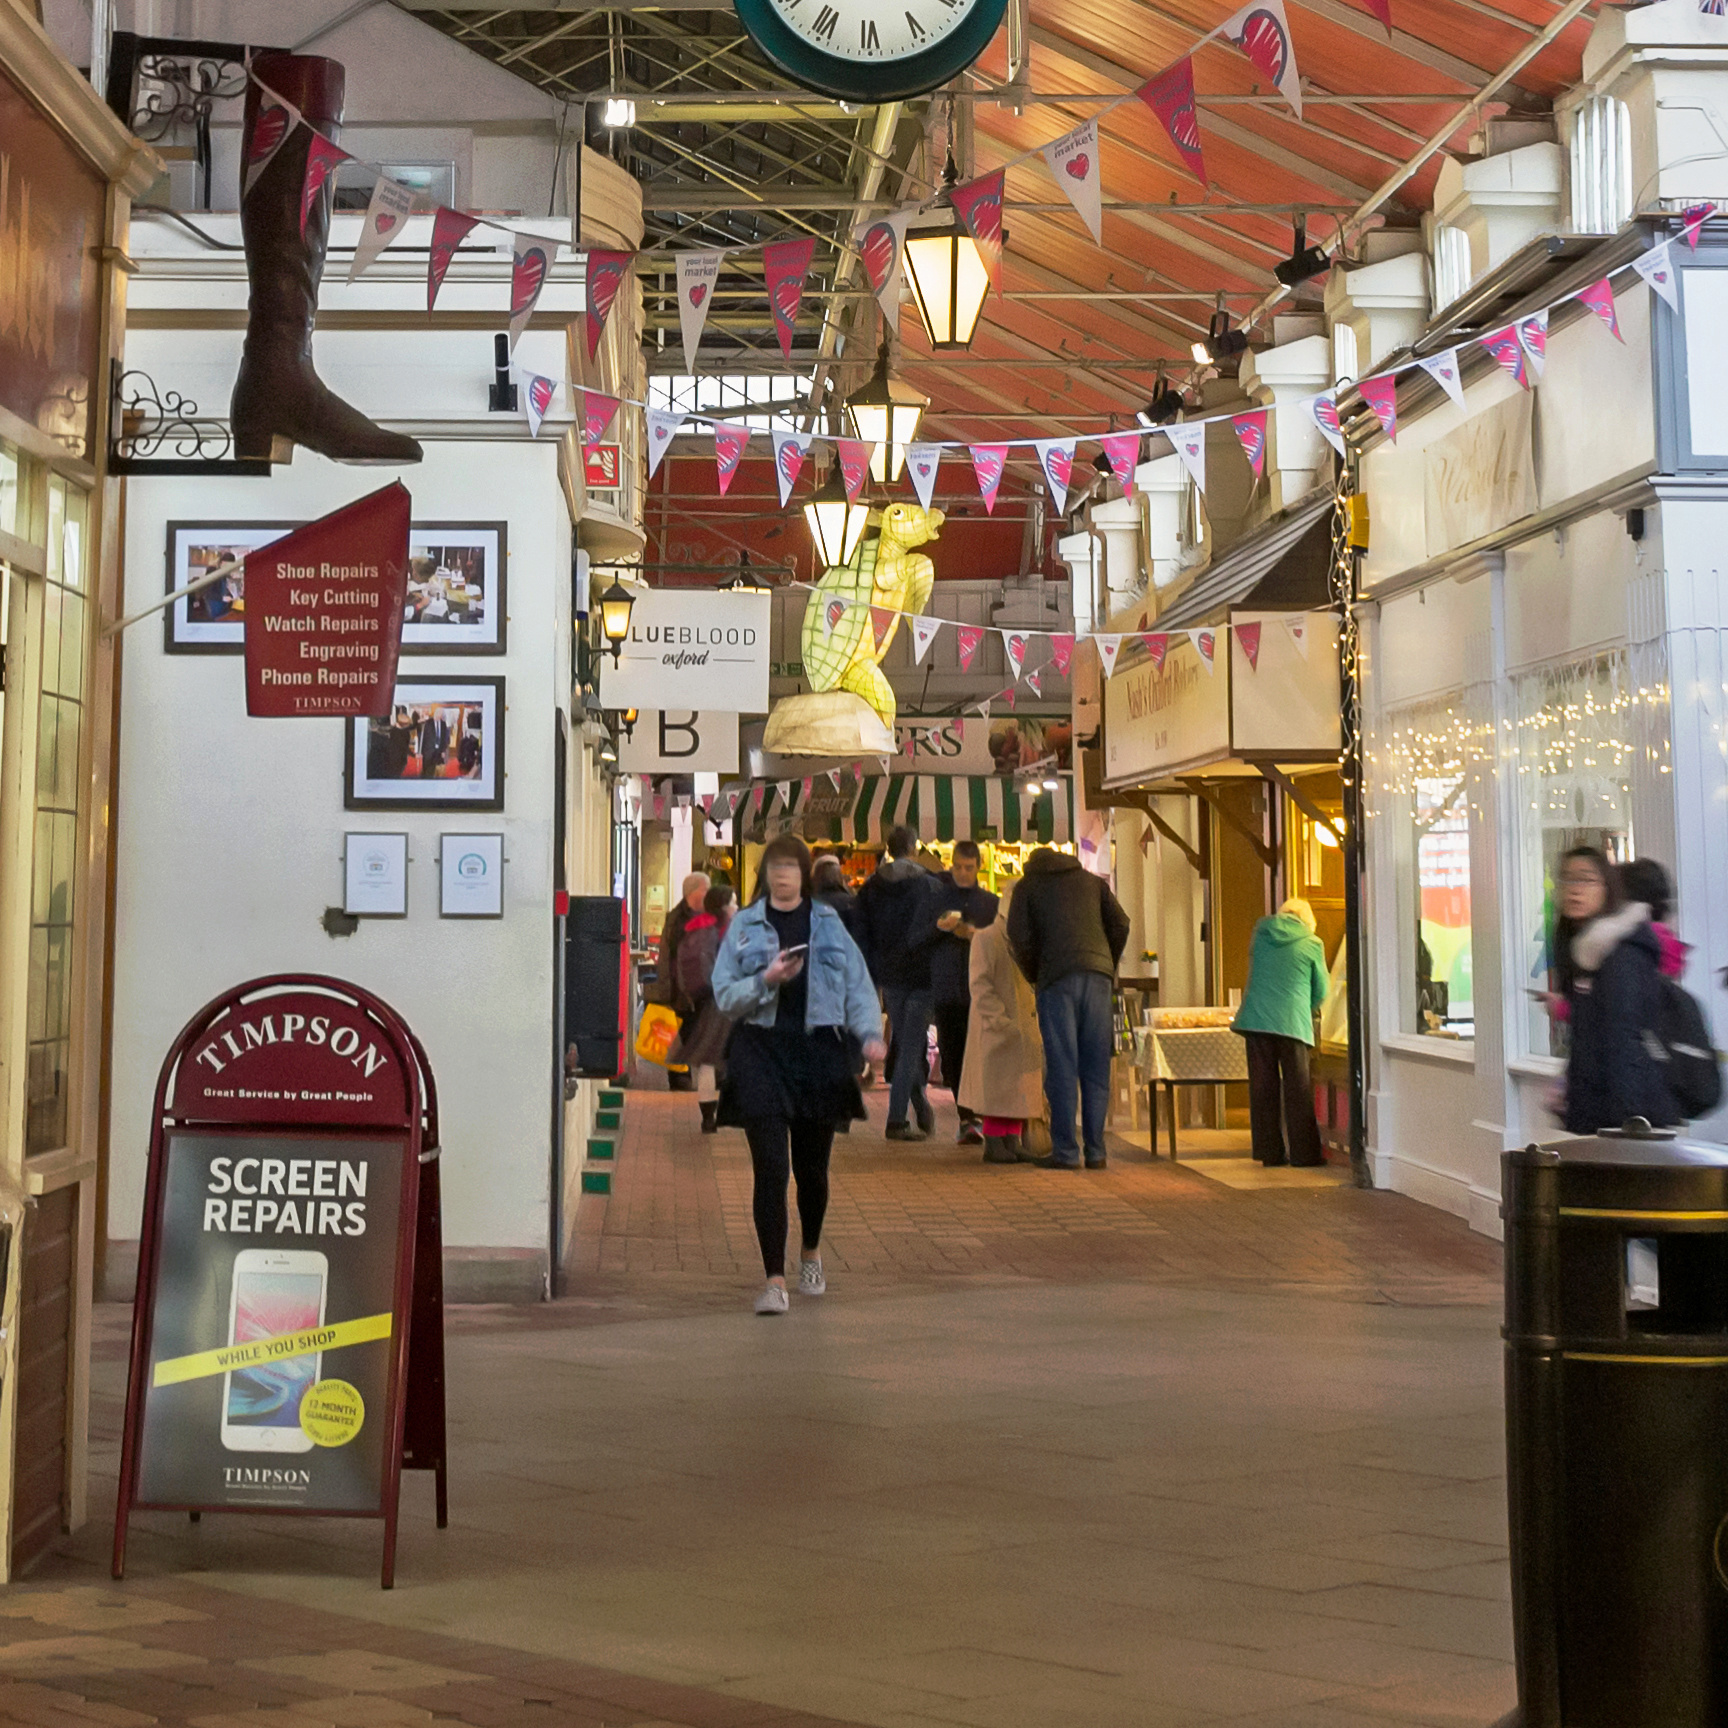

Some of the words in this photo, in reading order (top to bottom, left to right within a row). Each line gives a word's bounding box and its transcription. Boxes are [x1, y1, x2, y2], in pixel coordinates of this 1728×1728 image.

[1054, 132, 1094, 159] market
[684, 266, 717, 277] market
[276, 562, 315, 579] Shoe
[320, 562, 379, 582] Repairs
[290, 589, 319, 609] Key
[324, 588, 379, 608] Cutting
[264, 615, 315, 632] Watch
[320, 615, 379, 634] Repairs
[631, 626, 757, 646] LUEBLOOD
[300, 641, 379, 662] Engraving
[661, 649, 710, 670] oxford
[261, 668, 313, 685] Phone
[317, 668, 379, 688] Repairs
[293, 696, 363, 708] TIMPSON
[812, 797, 850, 812] FRUIT
[196, 1013, 388, 1079] TIMPSON
[203, 1087, 235, 1098] Great
[238, 1088, 280, 1100] Service
[283, 1089, 297, 1101] by
[300, 1090, 332, 1101] Great
[335, 1091, 374, 1103] People
[207, 1156, 368, 1198] SCREEN
[202, 1198, 368, 1237] REPAIRS
[216, 1345, 261, 1366] WHILE
[265, 1339, 295, 1356] YOU
[297, 1330, 337, 1349] SHOP
[322, 1401, 357, 1416] MONTH
[224, 1467, 311, 1484] TIMPSON
